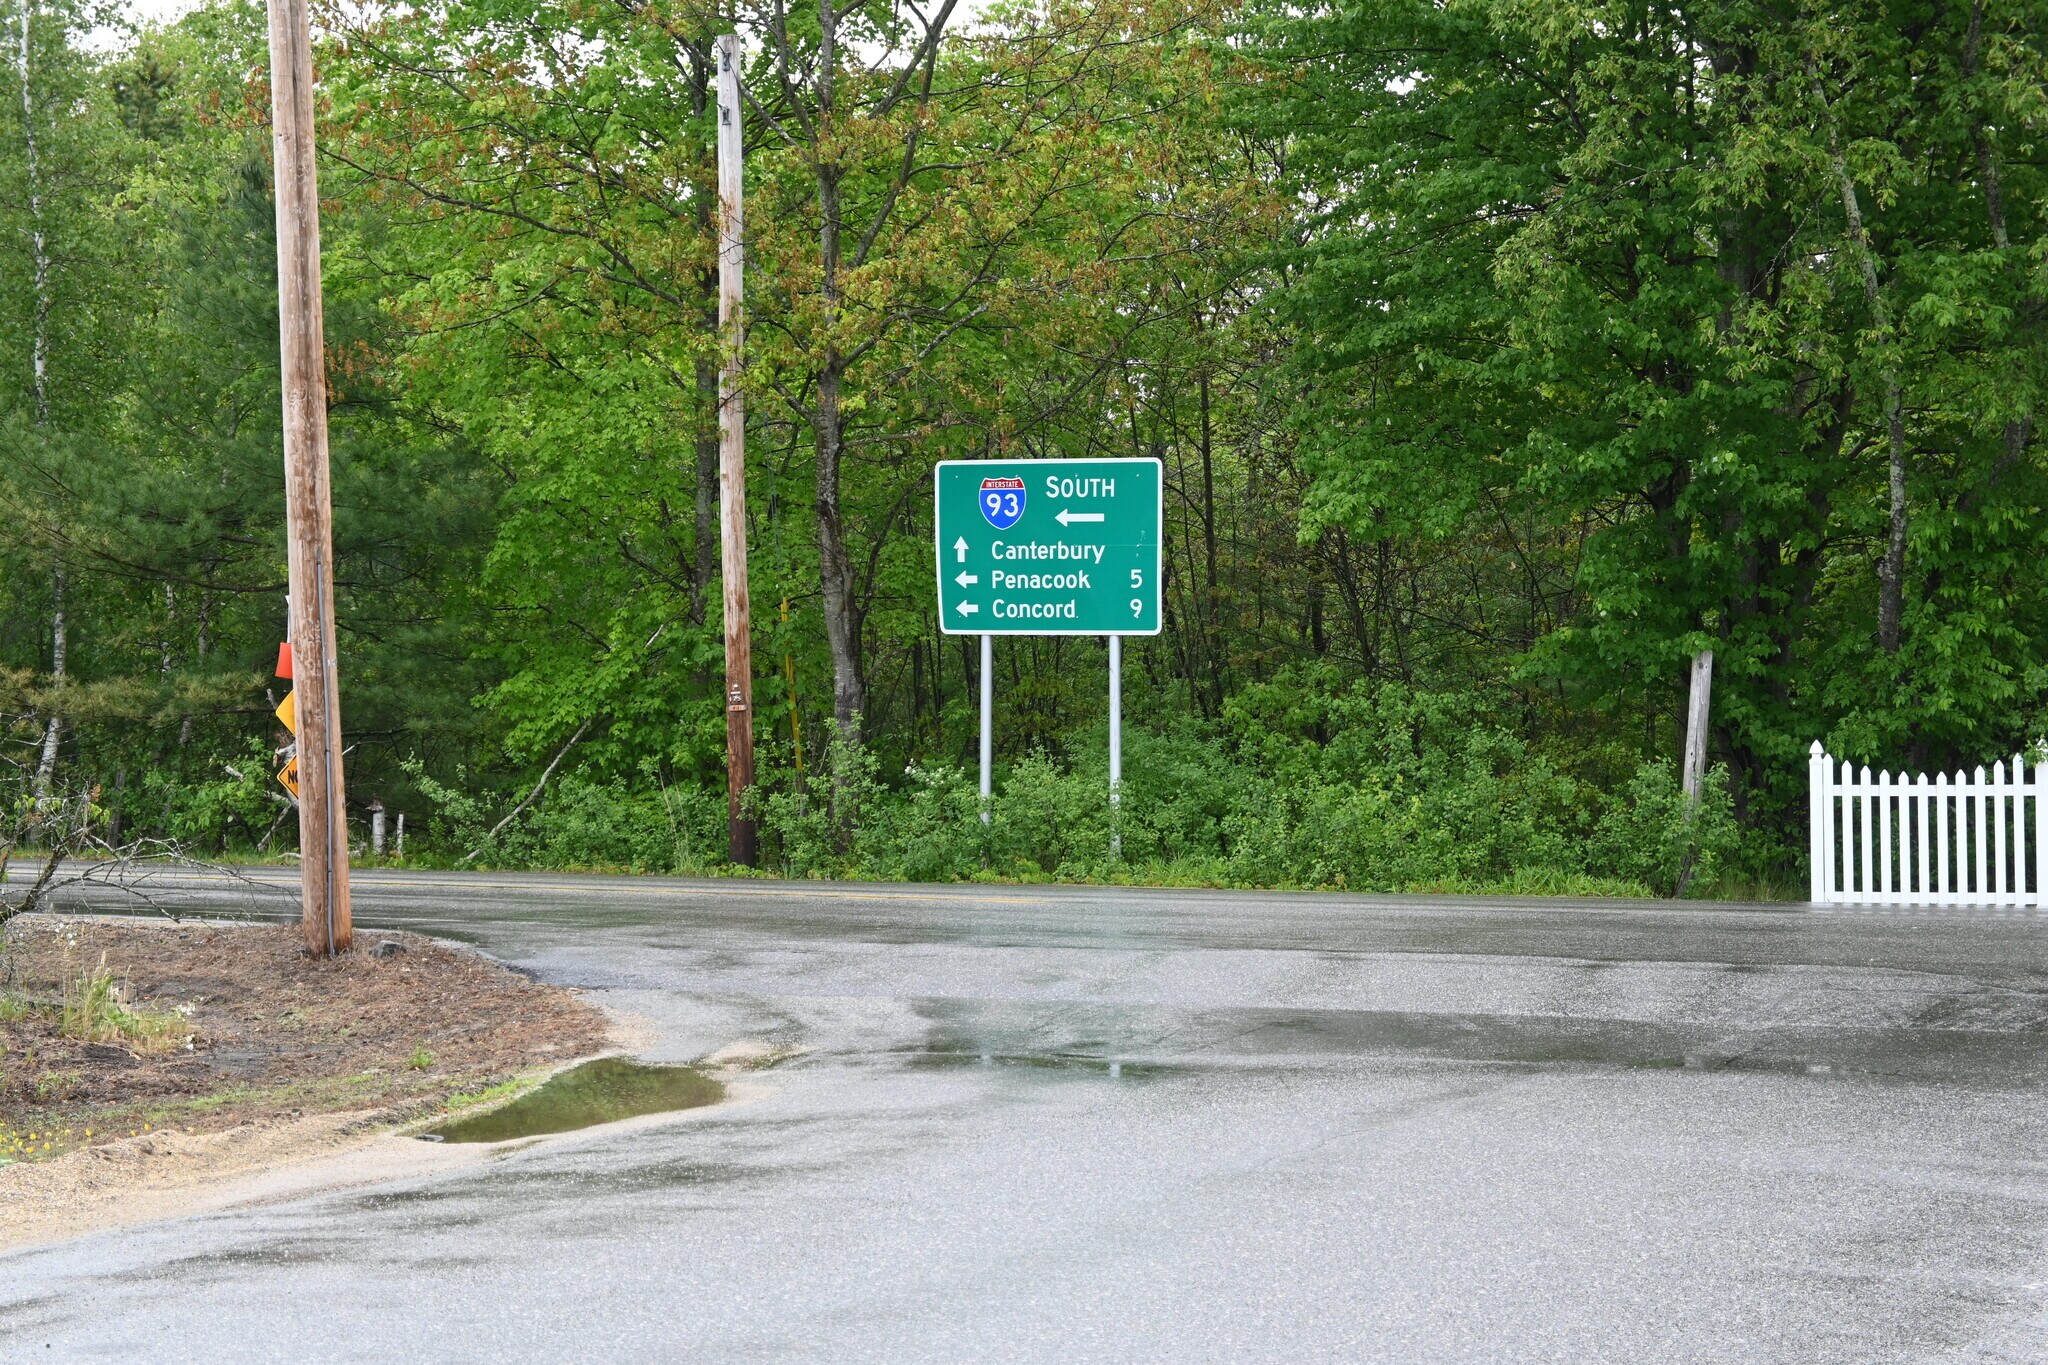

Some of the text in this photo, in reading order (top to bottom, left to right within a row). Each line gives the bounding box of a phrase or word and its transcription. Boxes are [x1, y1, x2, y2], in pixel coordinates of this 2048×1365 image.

[1045, 476, 1115, 498] SOUTH
[986, 493, 1019, 517] 93
[991, 540, 1106, 564] Canterbury
[992, 569, 1143, 589] Penacook 5
[992, 599, 1143, 618] Concord 9
